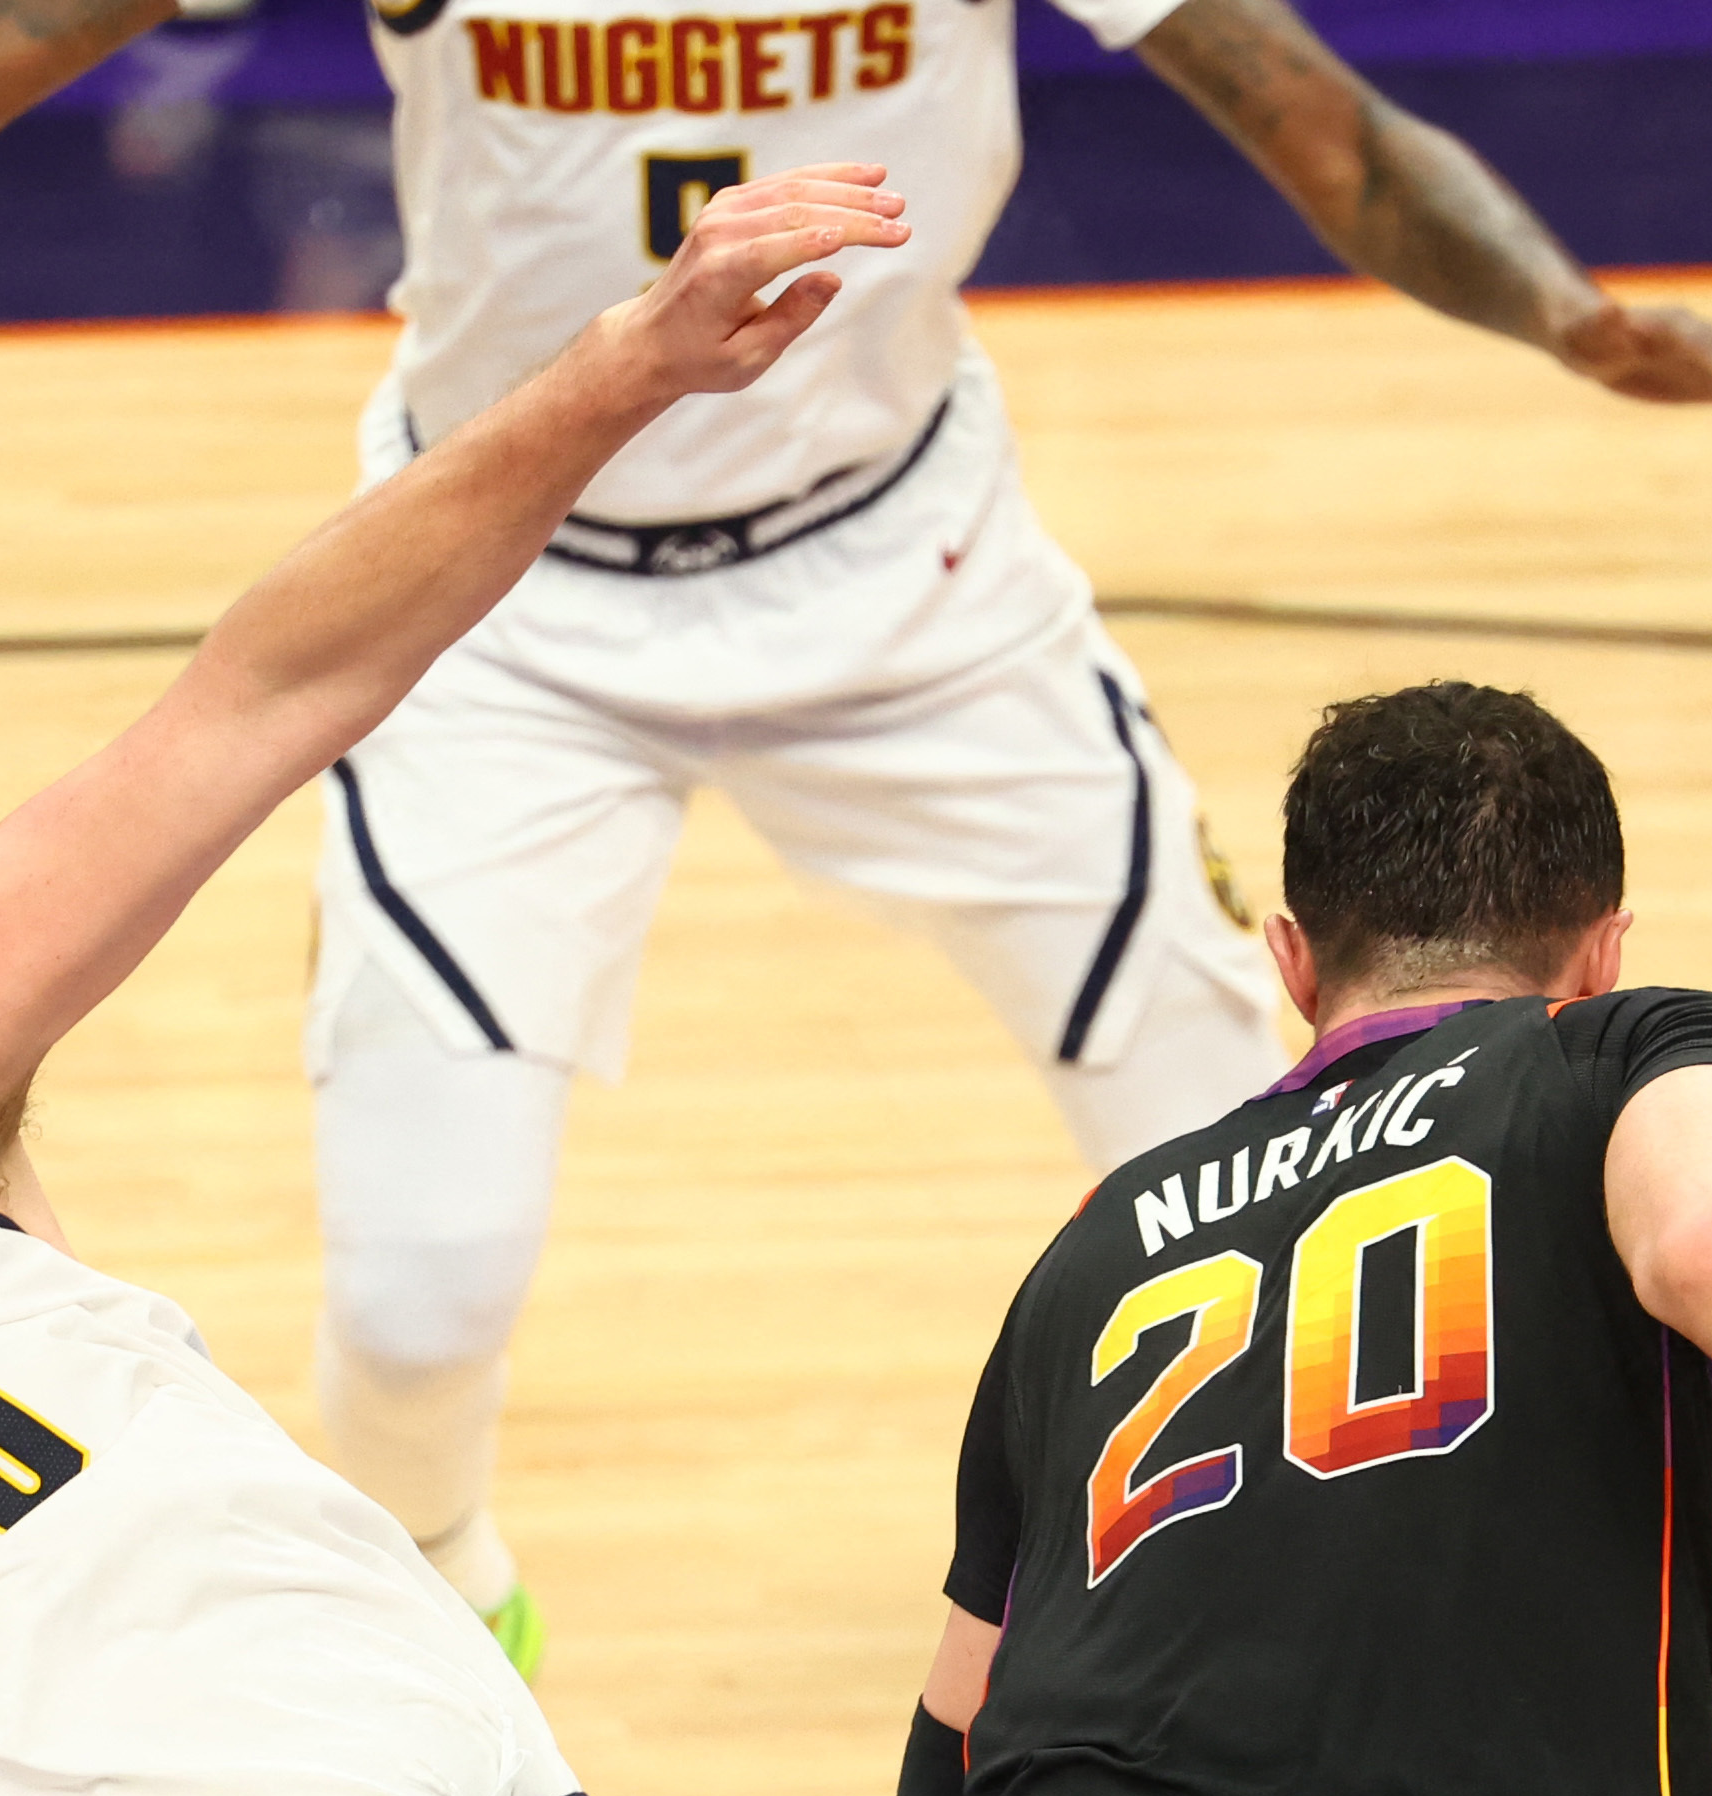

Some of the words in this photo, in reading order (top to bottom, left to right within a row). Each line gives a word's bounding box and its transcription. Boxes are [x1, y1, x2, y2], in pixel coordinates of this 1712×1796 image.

[465, 3, 914, 115] NUGGETS
[1134, 1047, 1479, 1257] NURKIĆ
[1089, 1156, 1494, 1589] 20
